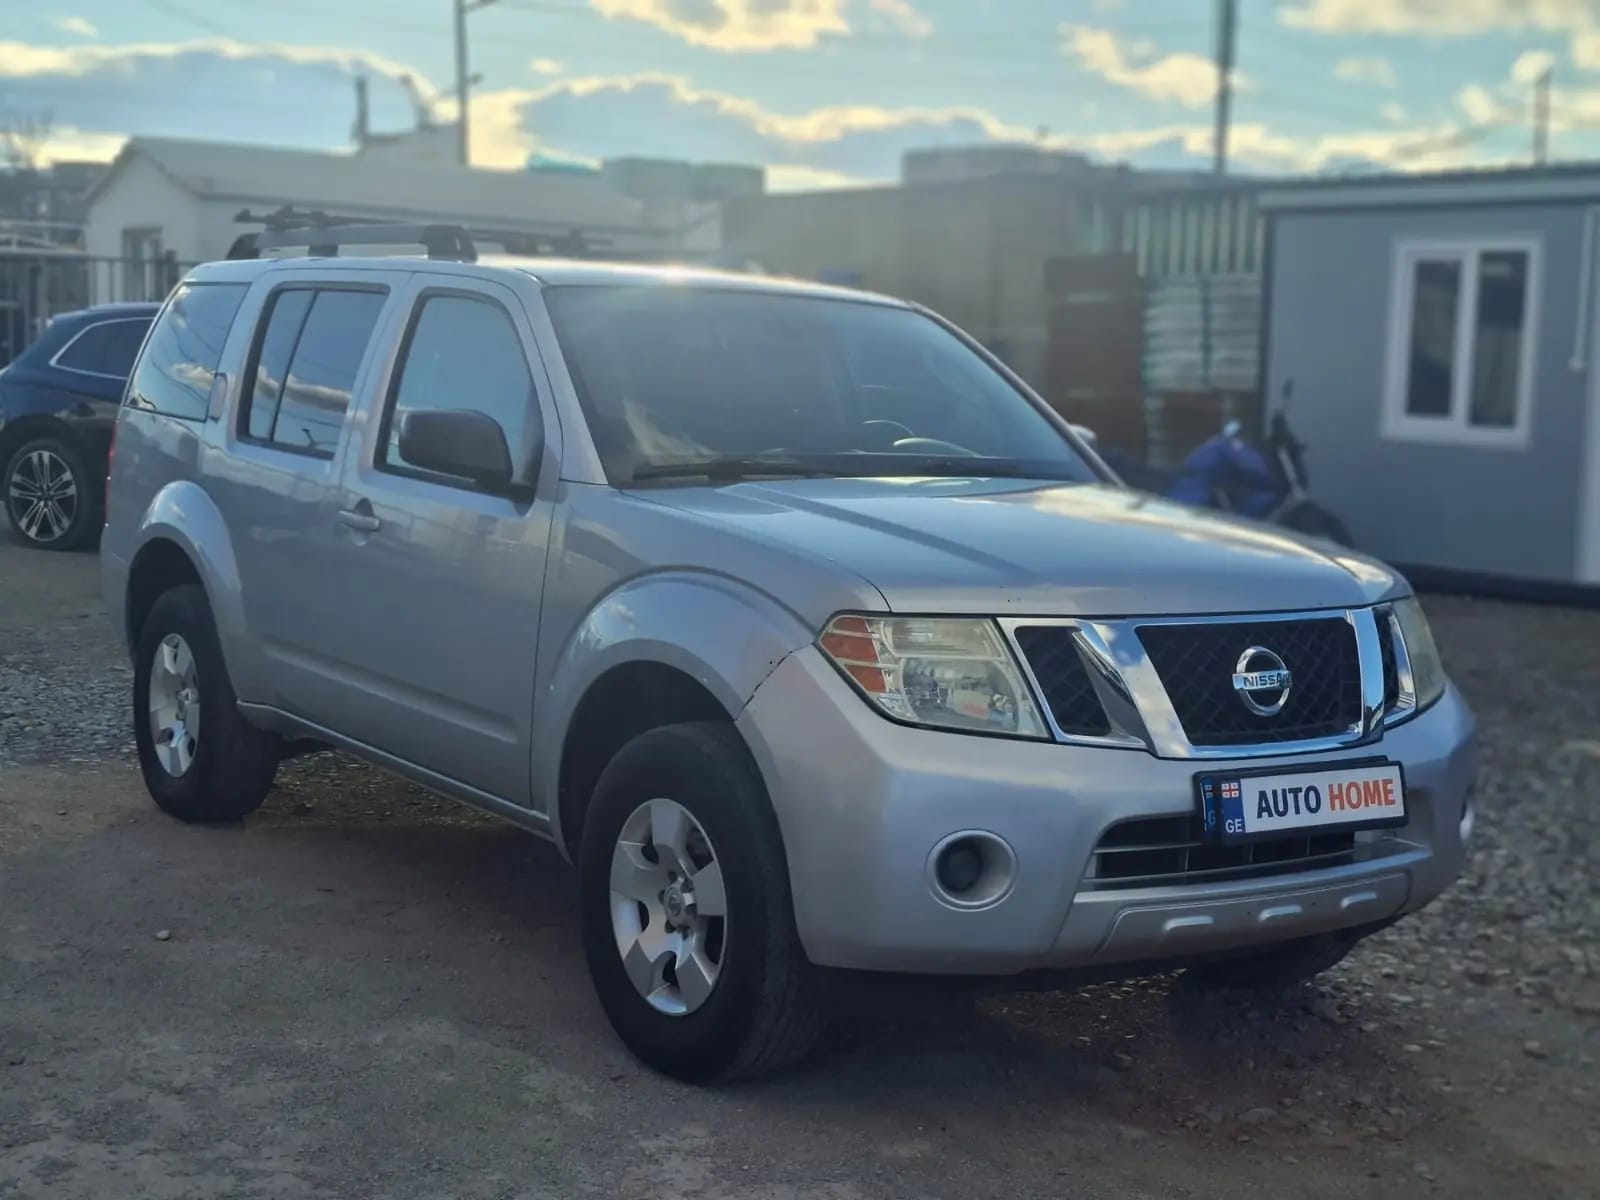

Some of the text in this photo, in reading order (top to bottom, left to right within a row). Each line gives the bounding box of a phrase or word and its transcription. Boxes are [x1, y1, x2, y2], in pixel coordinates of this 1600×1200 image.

[1243, 673, 1290, 687] NISSAN
[1257, 778, 1396, 818] AUTO HOME
[1225, 818, 1243, 833] GE
